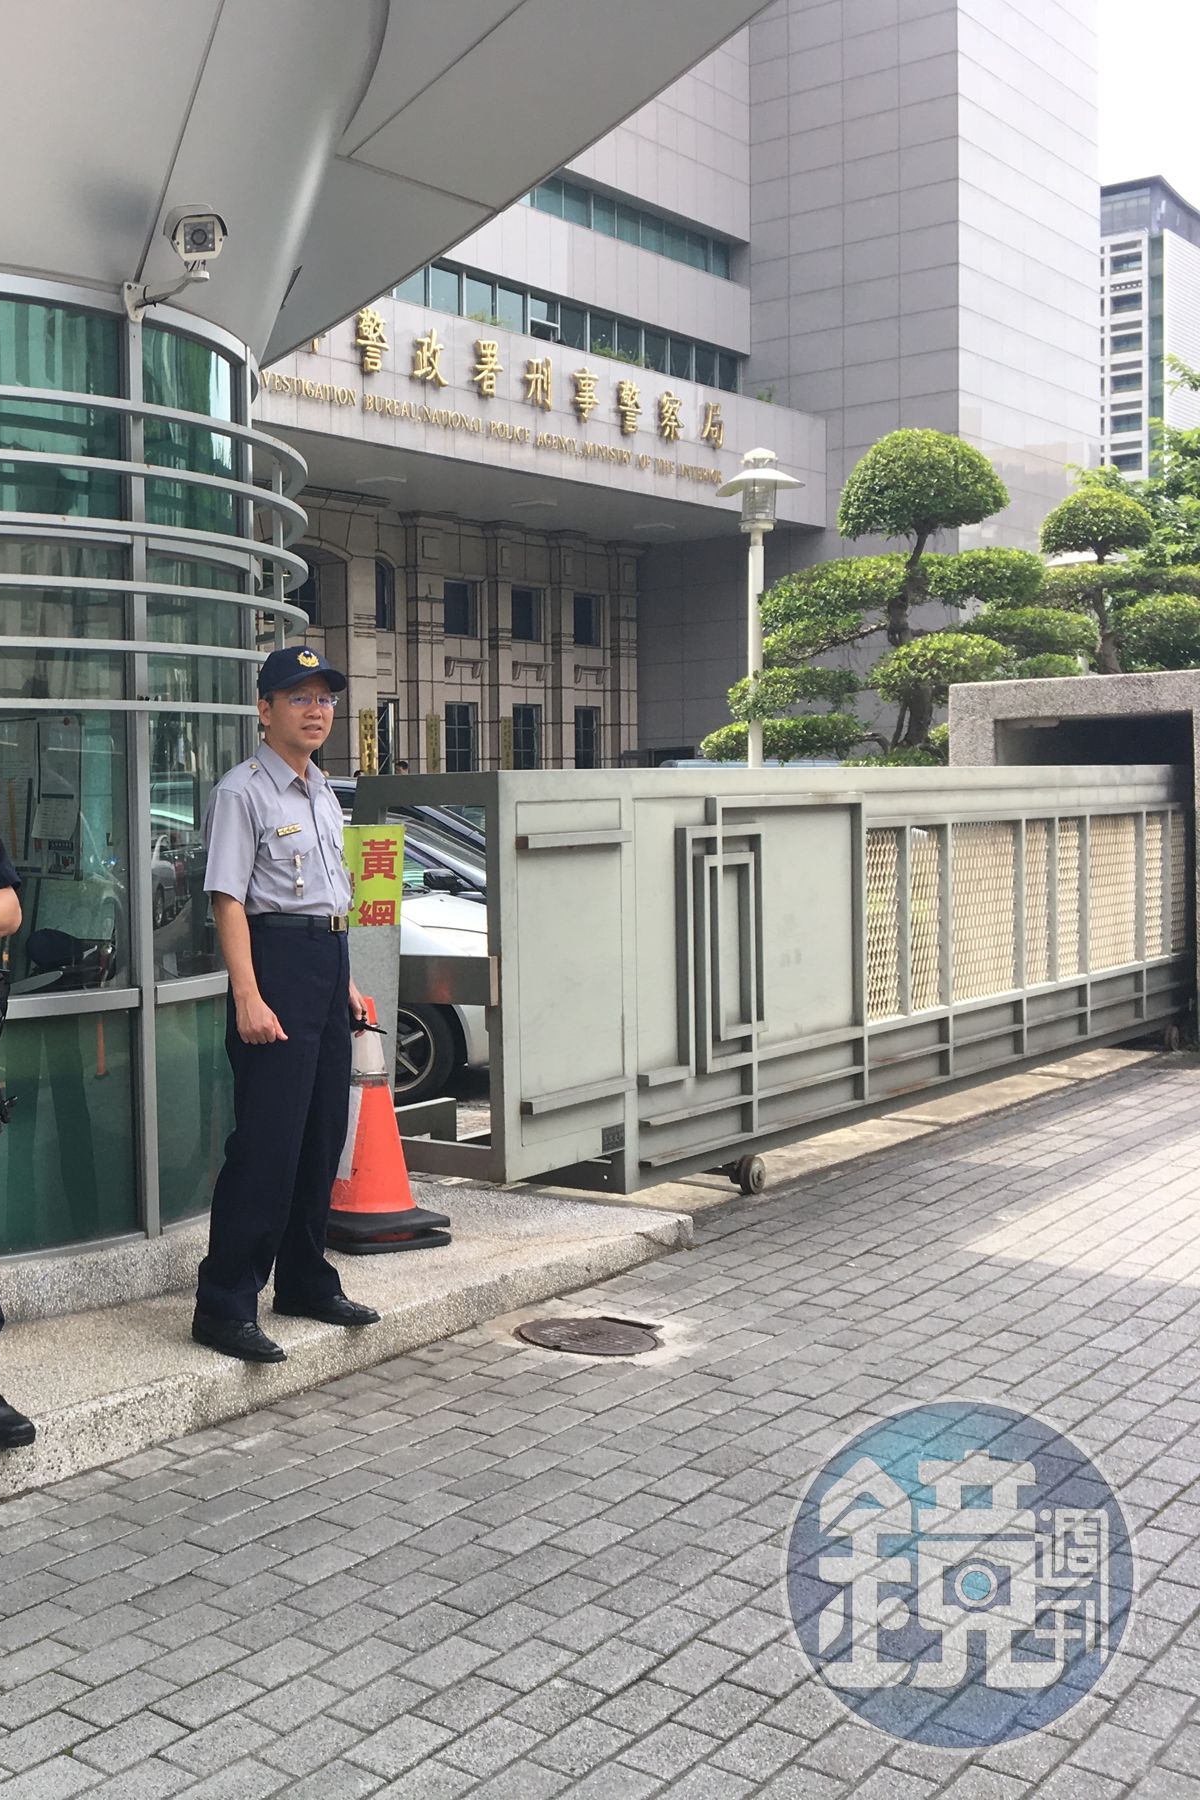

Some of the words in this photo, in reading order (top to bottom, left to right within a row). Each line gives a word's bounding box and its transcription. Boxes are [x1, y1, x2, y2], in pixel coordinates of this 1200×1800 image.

[311, 307, 724, 449] 警政署刑事警察局
[490, 420, 531, 443] POLICE
[583, 441, 632, 465] MINISTRY
[639, 453, 651, 470] OF
